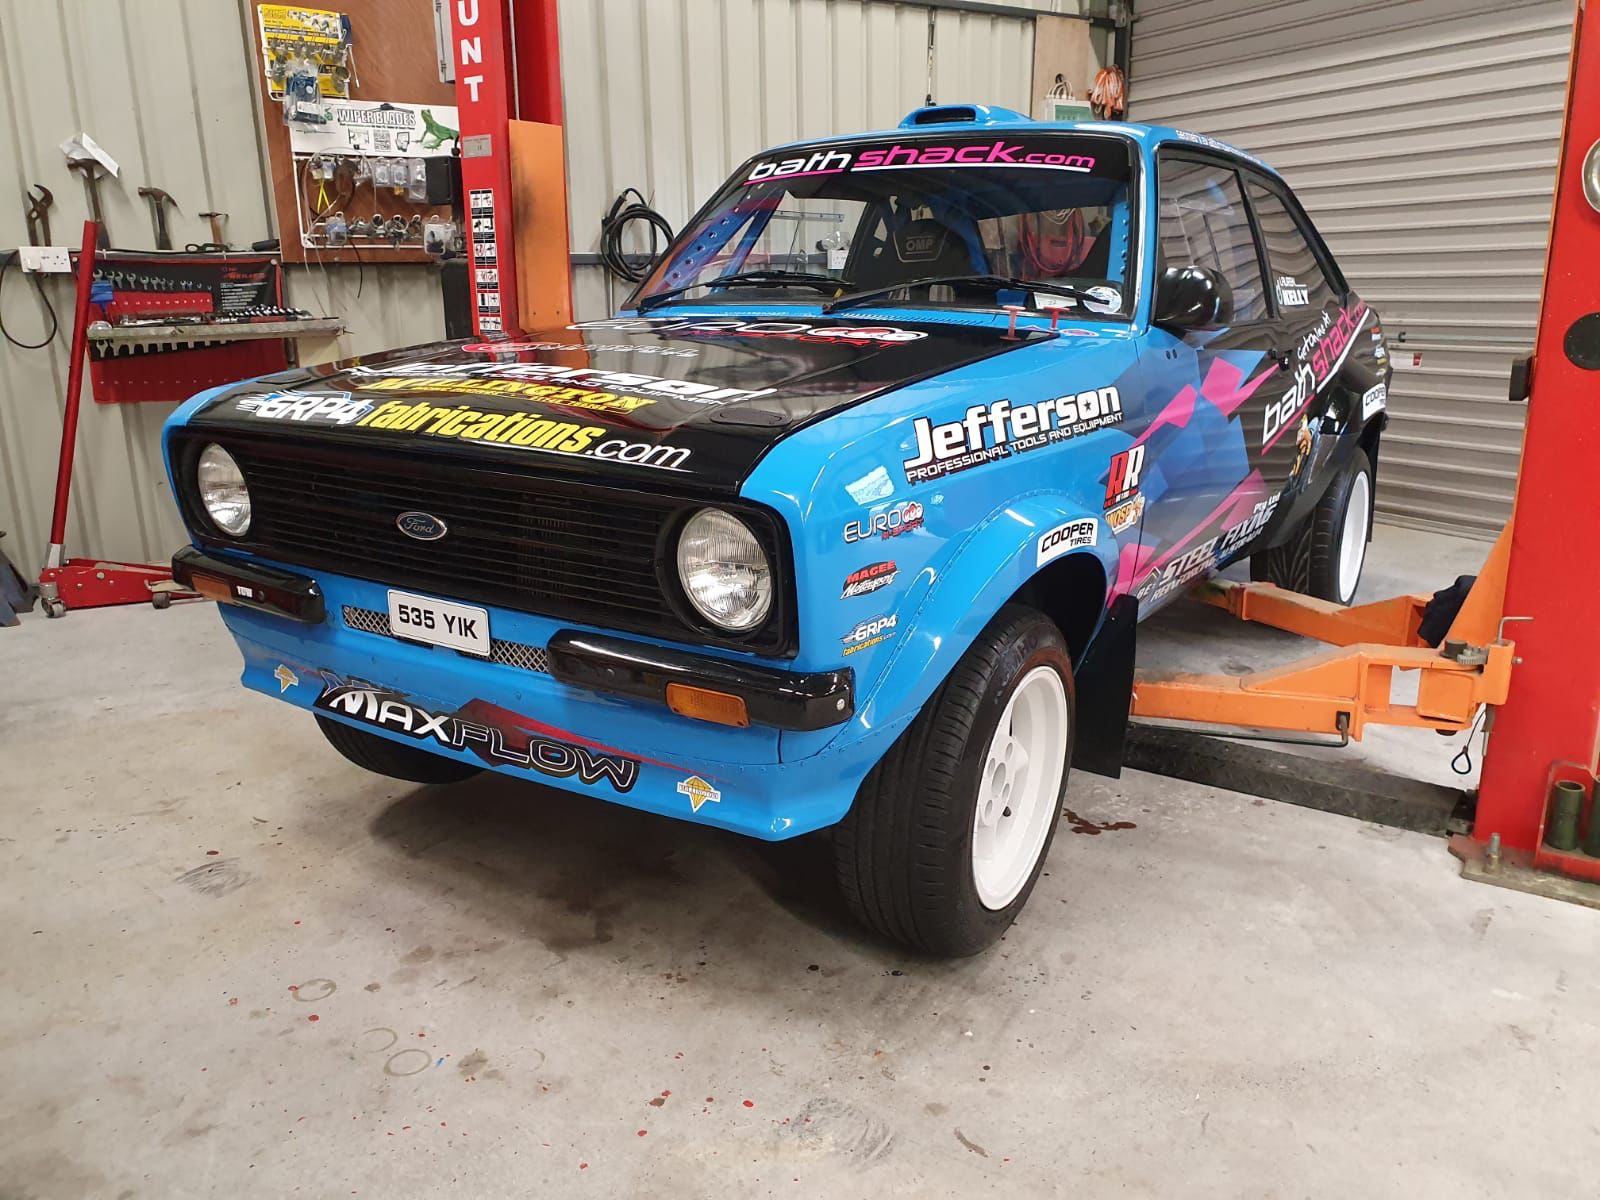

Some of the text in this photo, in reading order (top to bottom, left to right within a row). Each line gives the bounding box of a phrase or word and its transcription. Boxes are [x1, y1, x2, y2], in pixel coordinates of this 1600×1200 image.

[337, 109, 417, 126] WIPER BLADES
[905, 240, 934, 252] OMP
[904, 386, 1121, 470] Jefferson
[906, 412, 1123, 484] PROFESSIONAL TOOLS AND EQUIPMENT
[403, 516, 435, 535] Ford
[844, 508, 902, 543] EURO
[1041, 522, 1095, 553] COOPER
[1070, 537, 1093, 548] TIRES
[1159, 536, 1220, 587] STEEL
[1220, 503, 1279, 550] FIXING
[846, 560, 897, 584] MAGEE
[398, 604, 479, 640] 535 YIK
[855, 613, 898, 642] GRP4
